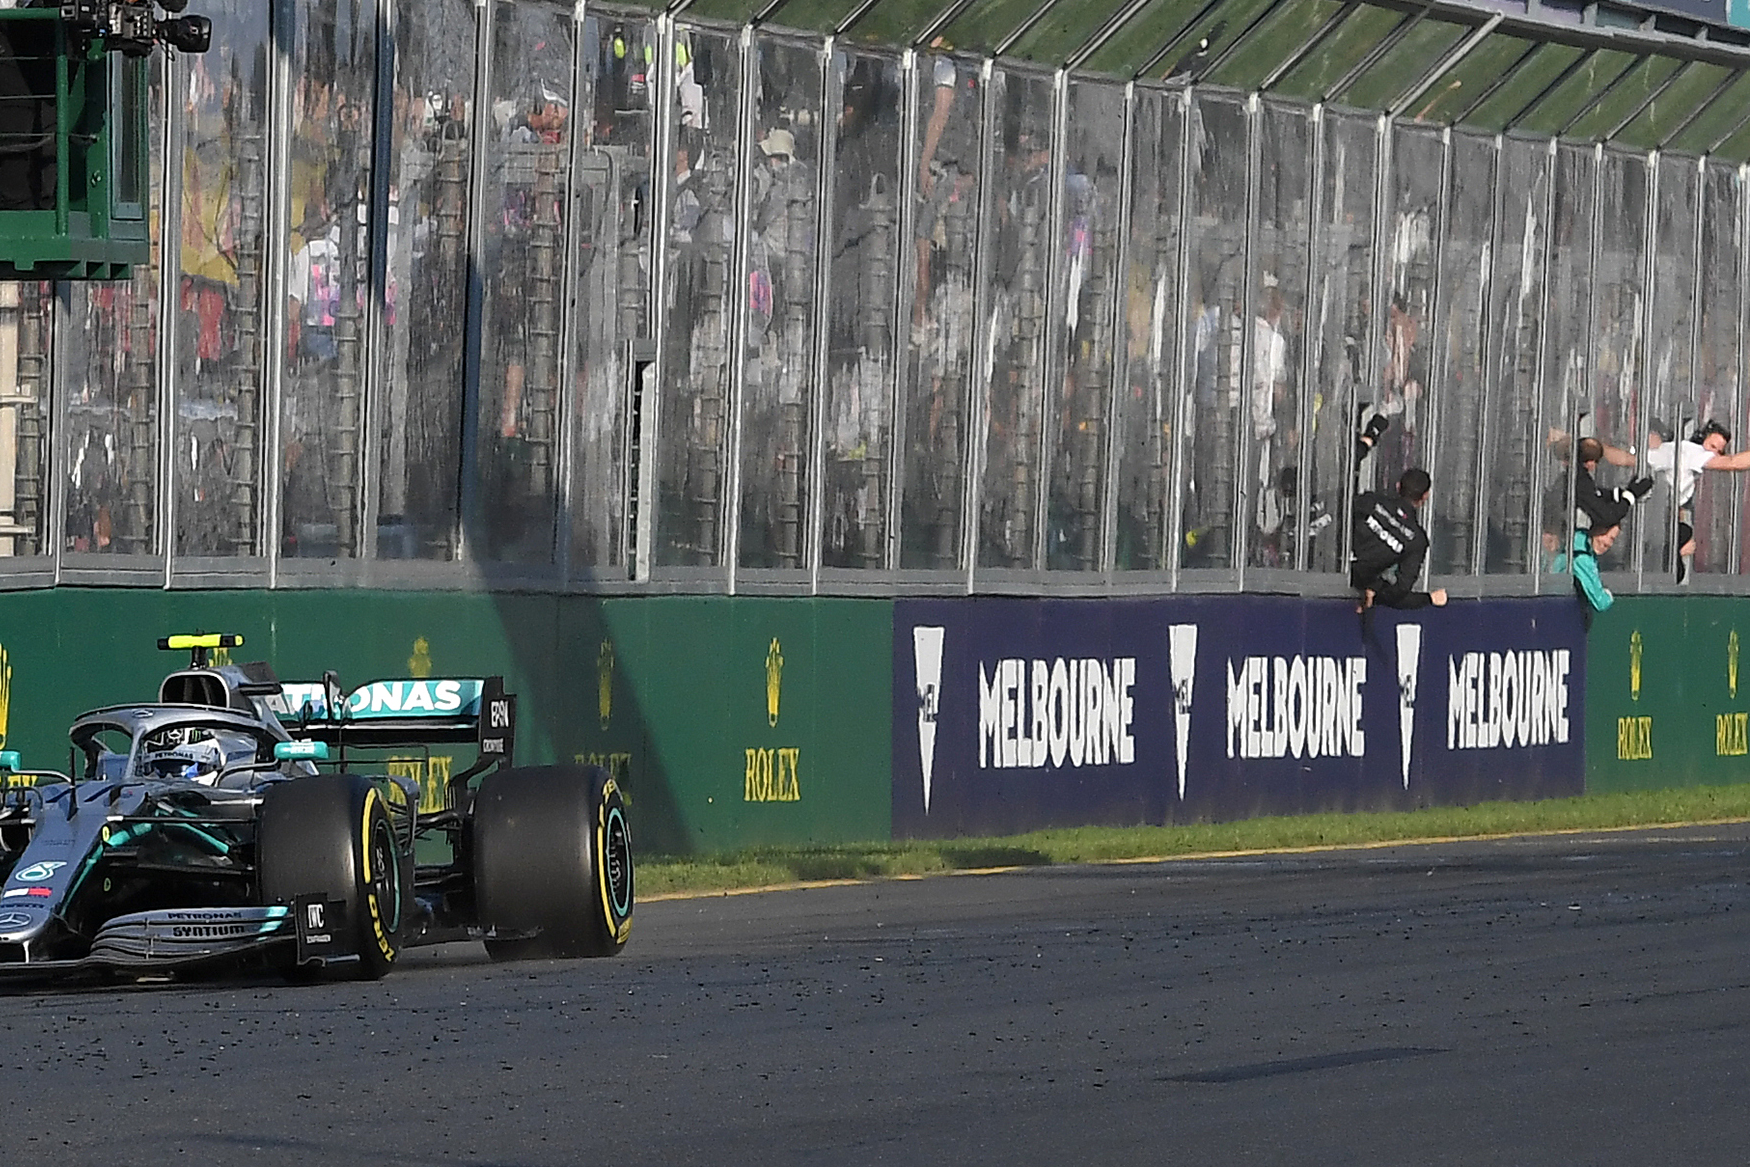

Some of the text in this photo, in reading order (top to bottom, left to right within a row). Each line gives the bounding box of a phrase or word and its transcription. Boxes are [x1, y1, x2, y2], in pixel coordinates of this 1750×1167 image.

[979, 657, 1136, 768] MELBOURNE
[1226, 655, 1367, 759] MELBOURNE
[1448, 649, 1570, 750] MELBOURNE
[1617, 716, 1652, 760] ROLEX
[1716, 713, 1749, 756] ROLEX
[744, 747, 801, 802] ROLEX
[167, 911, 243, 920] PETRONAS
